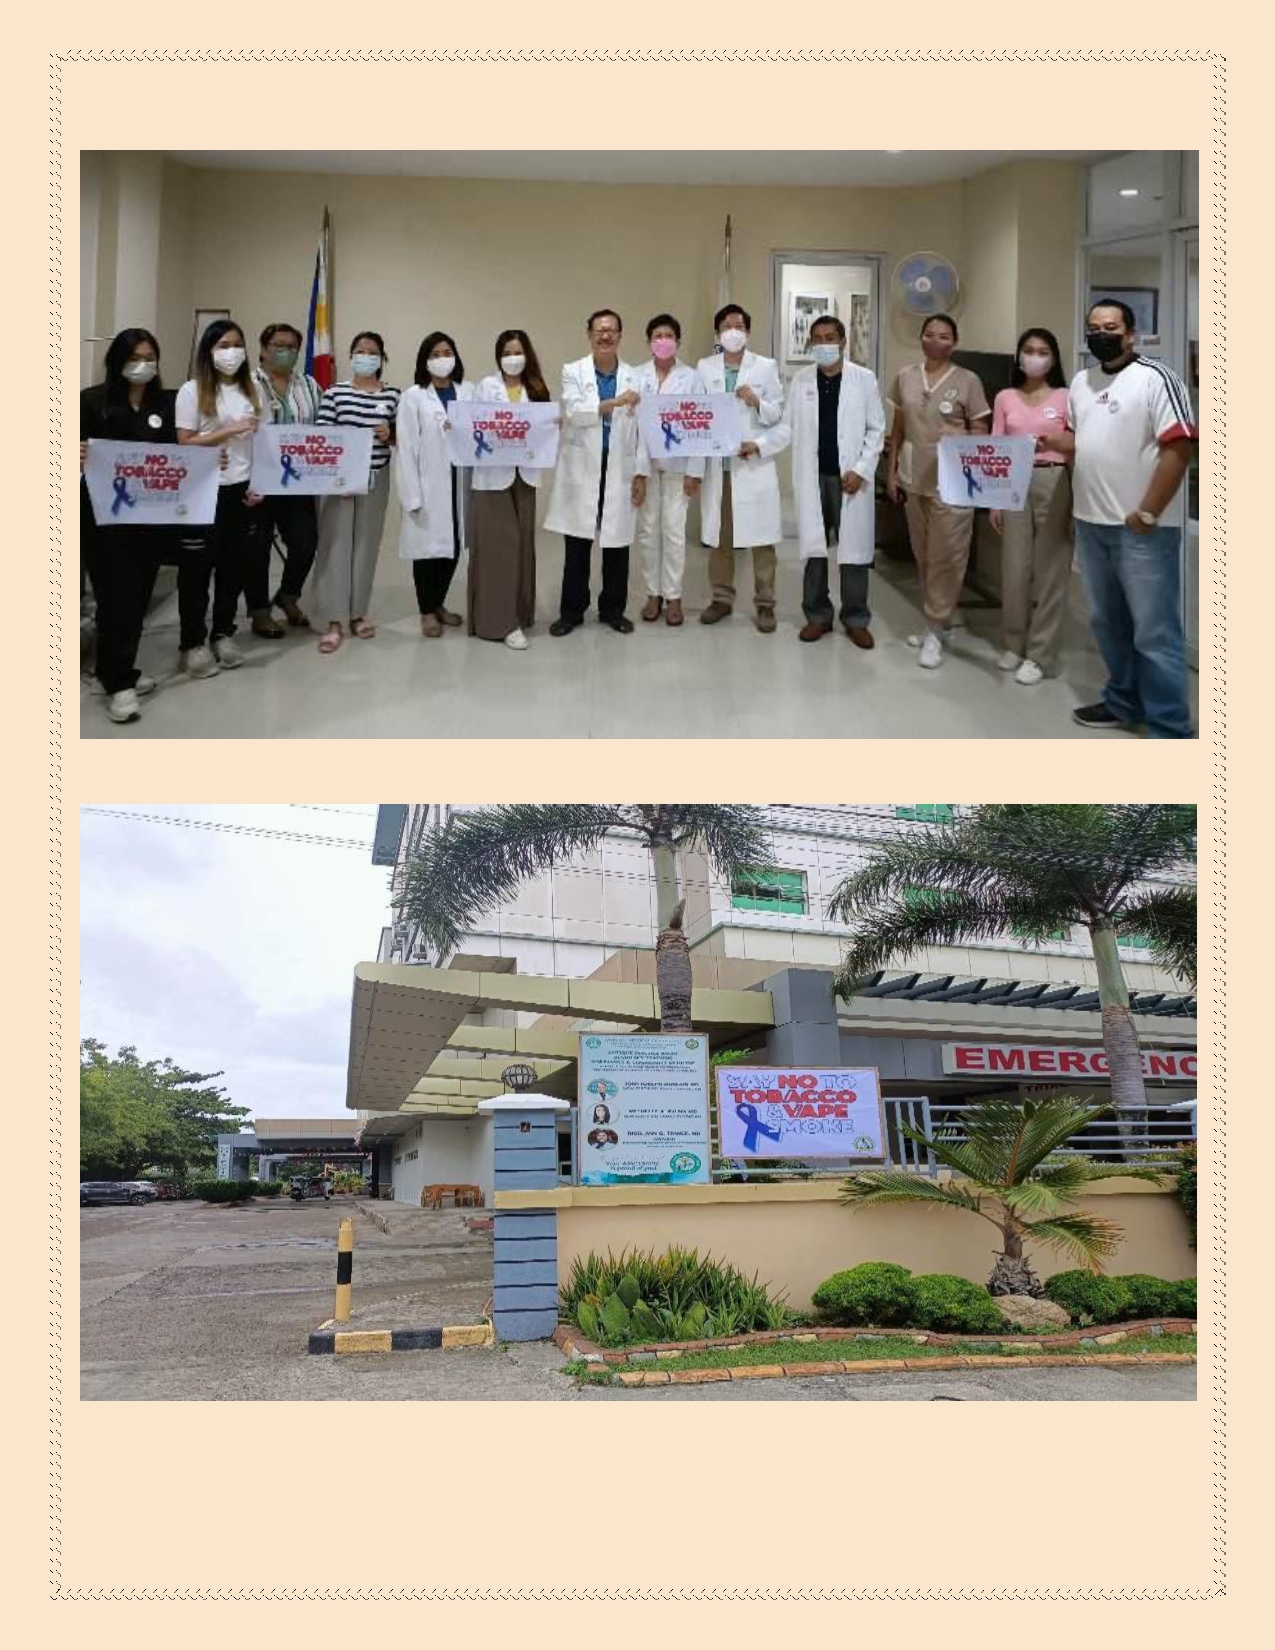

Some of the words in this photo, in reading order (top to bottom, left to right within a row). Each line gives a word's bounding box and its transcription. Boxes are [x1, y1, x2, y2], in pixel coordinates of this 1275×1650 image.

[680, 401, 697, 411] NO
[495, 411, 513, 420] NO
[659, 411, 713, 421] TOBACCO
[472, 420, 531, 431] TOBACCO
[682, 420, 710, 430] VAPE
[304, 435, 327, 444] NO
[496, 430, 526, 440] VAPE
[279, 444, 344, 455] TOBACCO
[976, 444, 995, 455] NO
[145, 454, 168, 466] NO
[304, 455, 338, 465] VAPE
[960, 456, 1011, 466] TOBACCO
[115, 465, 187, 479] TOBACCO
[982, 465, 1009, 477] VAPE
[143, 478, 179, 491] VAPE
[727, 1074, 776, 1089] SAY
[778, 1074, 818, 1089] NO
[820, 1074, 857, 1089] TO
[730, 1089, 857, 1104] TOBACCO
[767, 1104, 783, 1118] &
[782, 1104, 848, 1118] VAPE
[766, 1119, 855, 1134] SMOKE
